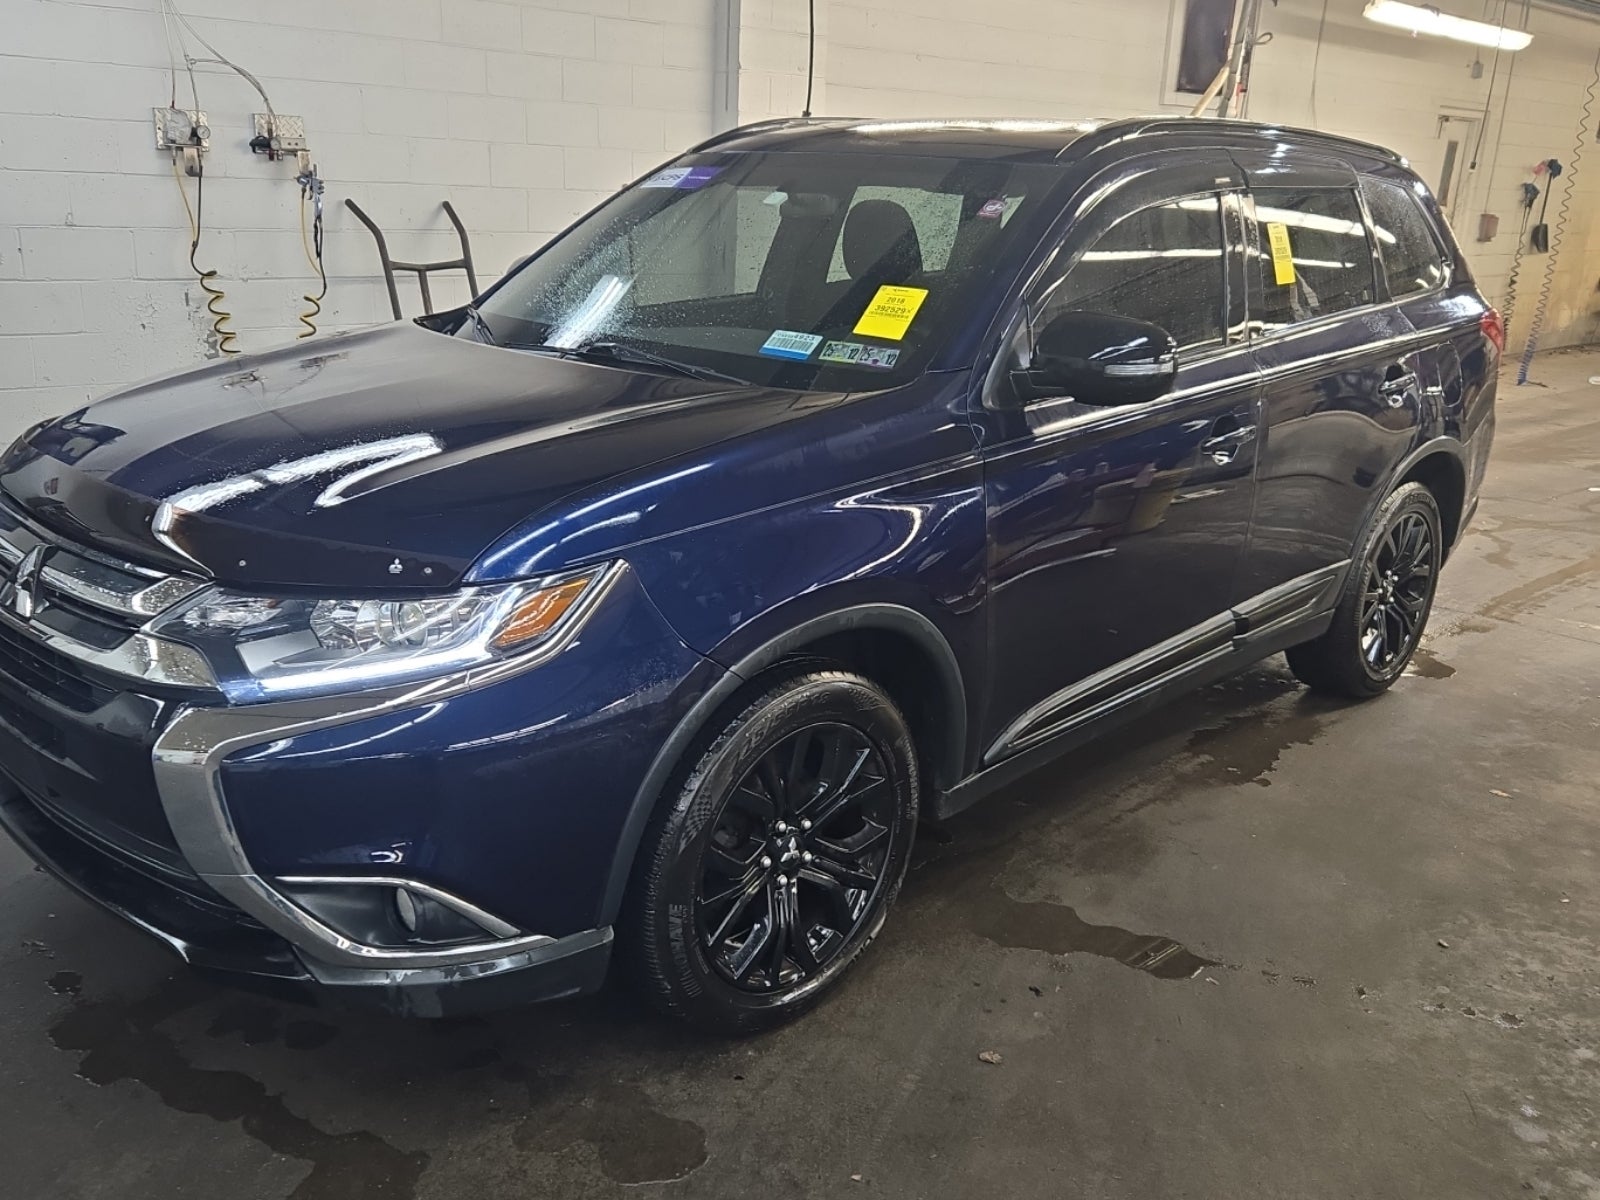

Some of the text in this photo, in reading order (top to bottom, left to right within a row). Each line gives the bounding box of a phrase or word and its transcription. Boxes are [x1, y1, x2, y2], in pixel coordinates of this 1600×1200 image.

[847, 347, 860, 360] 12
[859, 348, 898, 366] 25 12
